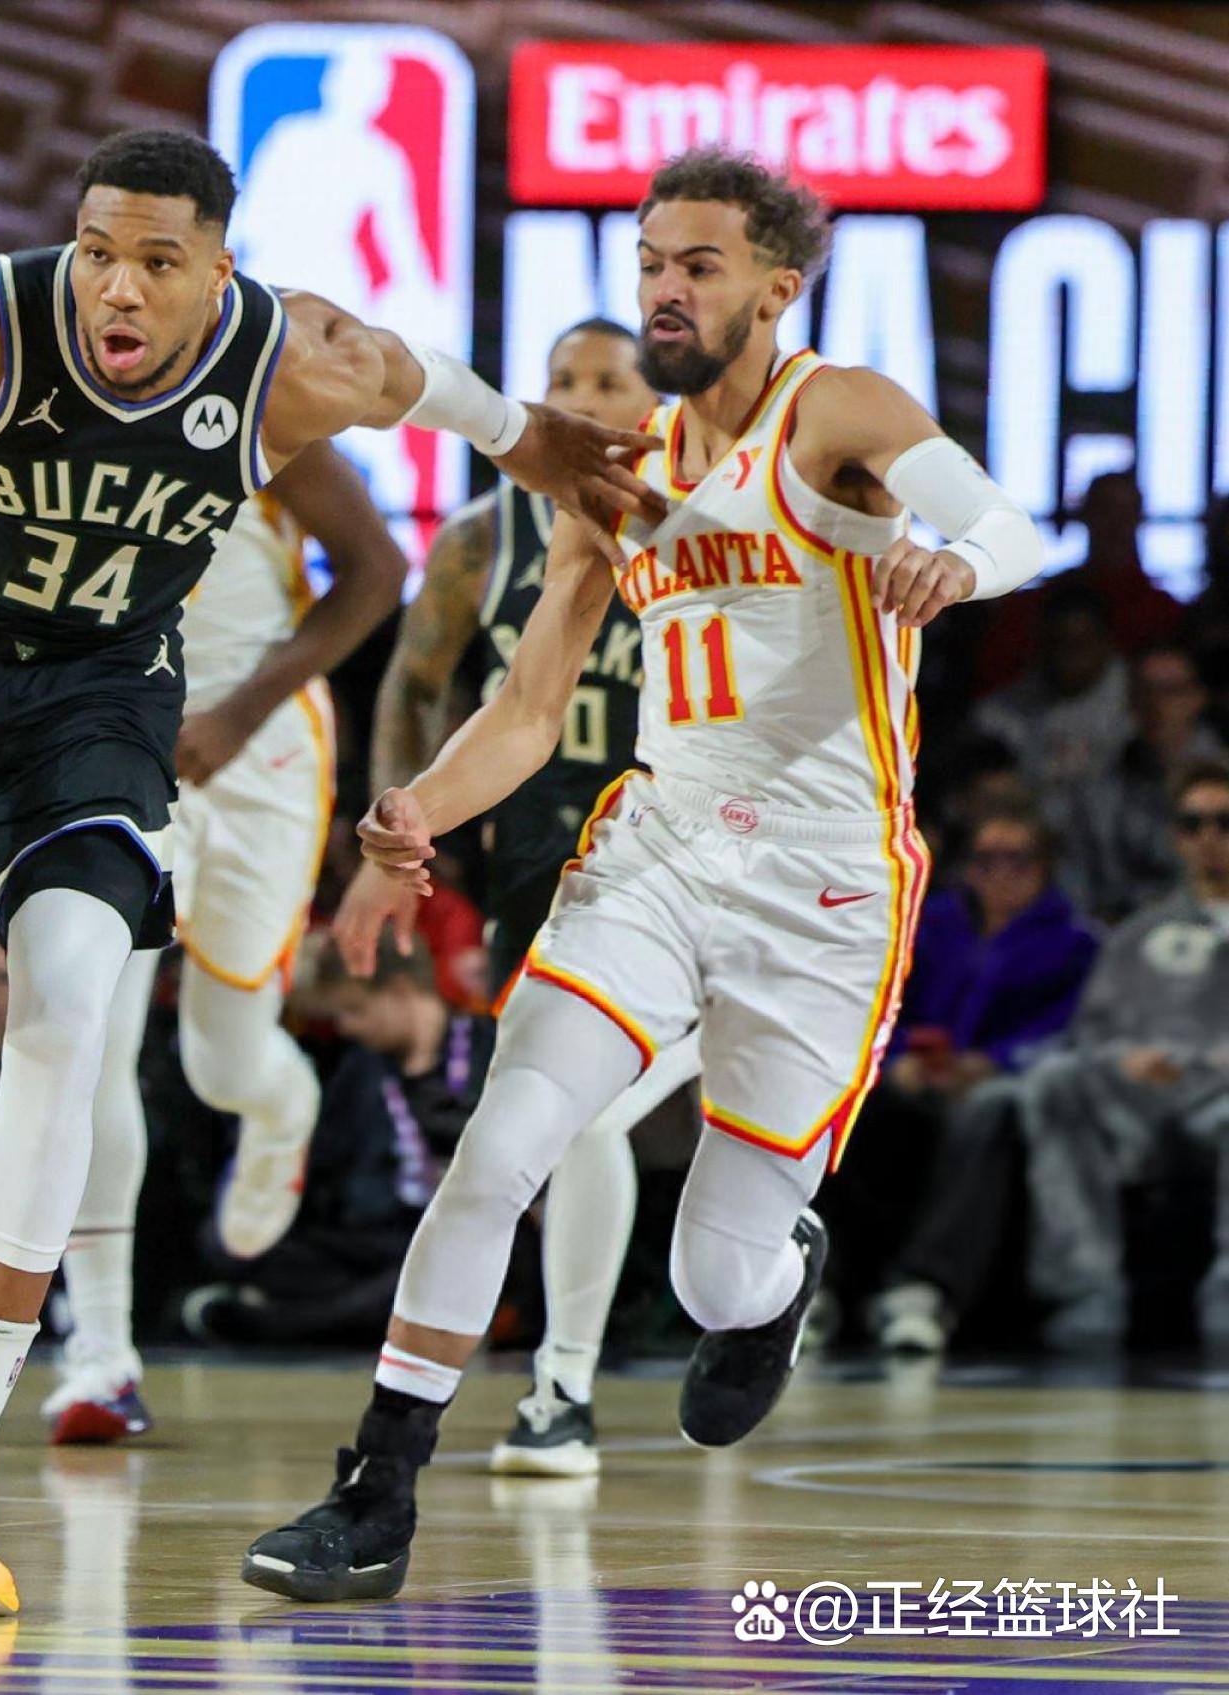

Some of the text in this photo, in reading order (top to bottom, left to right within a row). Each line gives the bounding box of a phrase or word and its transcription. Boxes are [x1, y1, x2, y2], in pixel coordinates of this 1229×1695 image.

[547, 63, 1014, 177] Emirates
[2, 524, 143, 626] 34
[660, 610, 746, 728] 11
